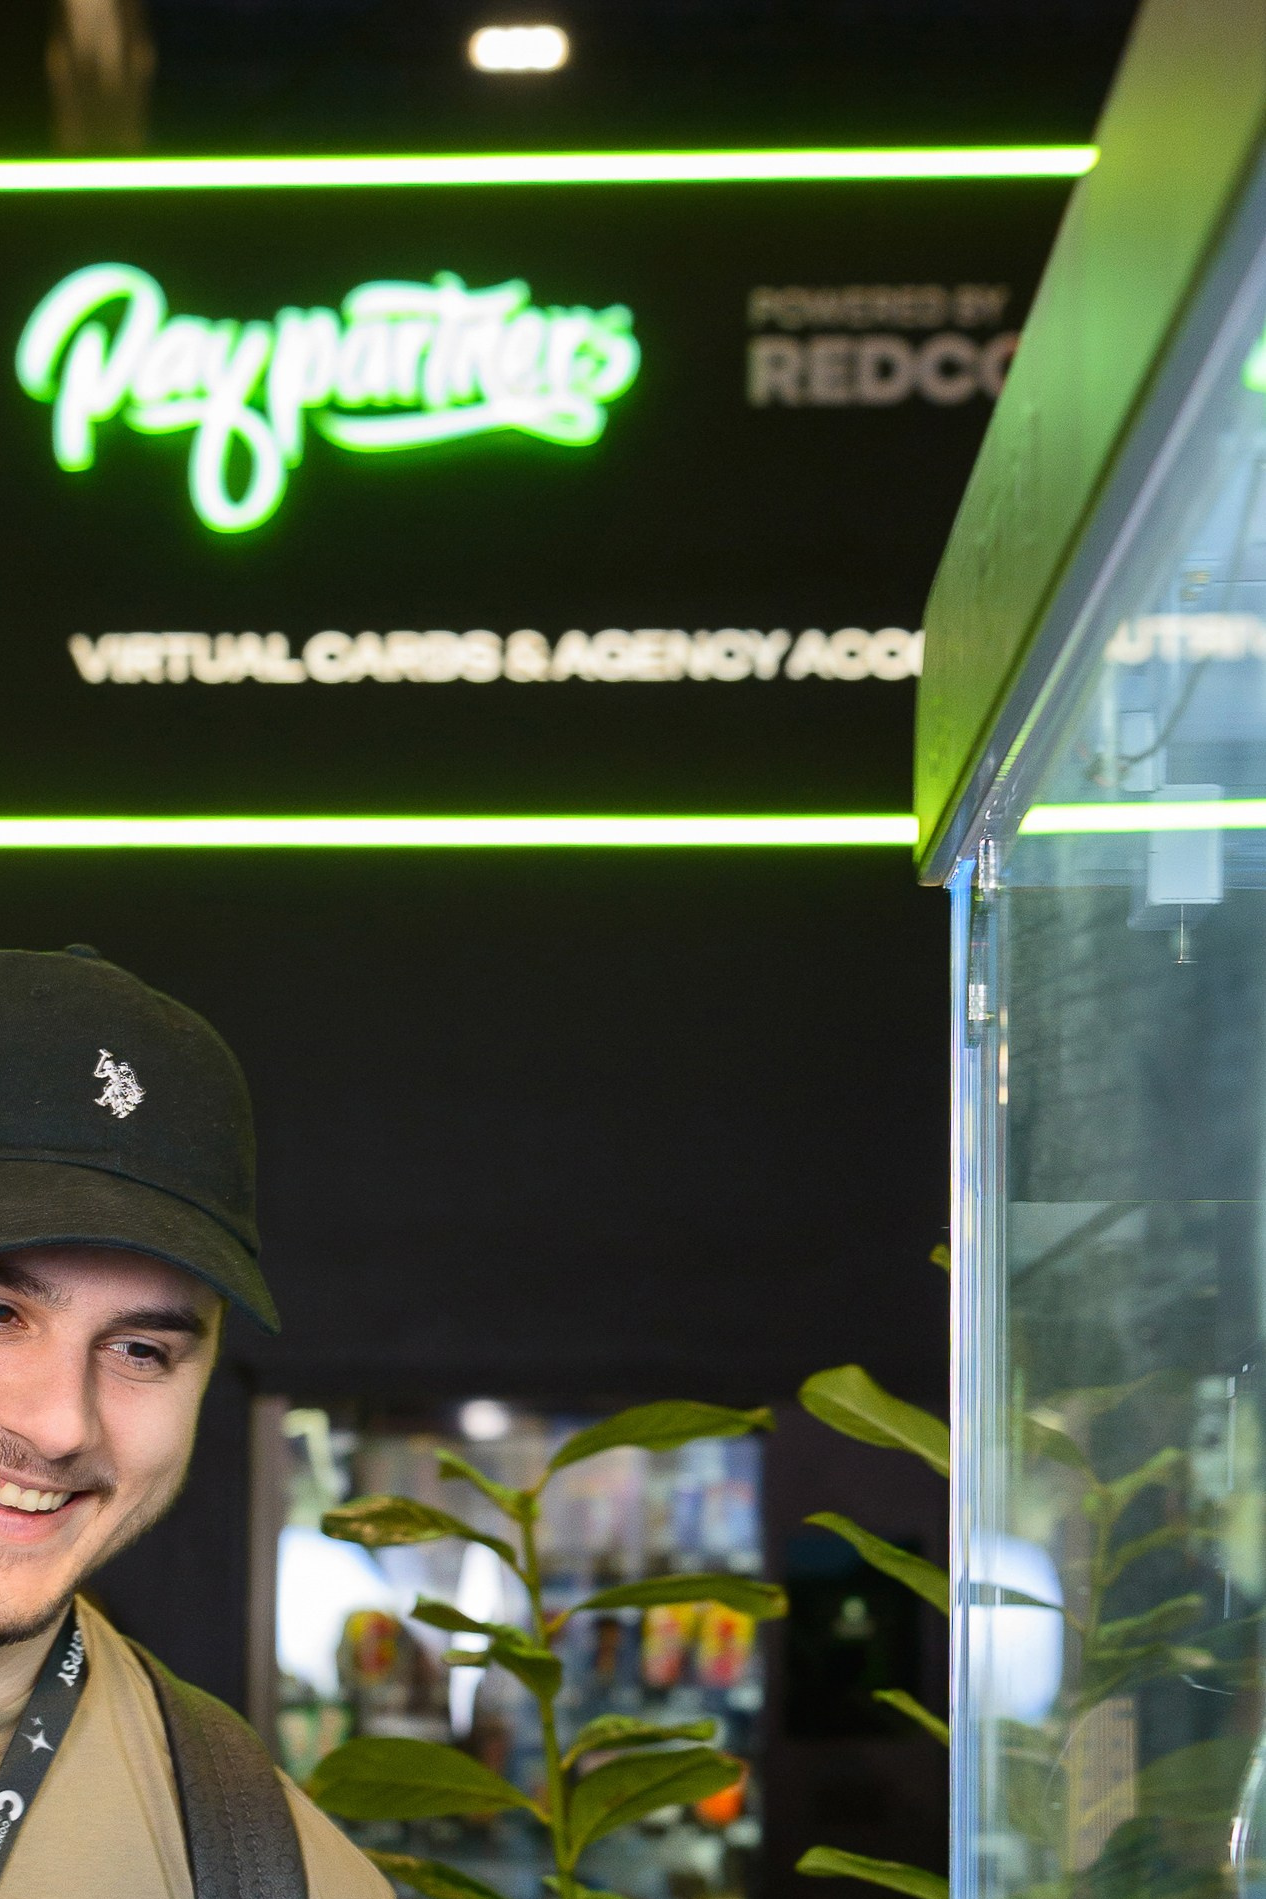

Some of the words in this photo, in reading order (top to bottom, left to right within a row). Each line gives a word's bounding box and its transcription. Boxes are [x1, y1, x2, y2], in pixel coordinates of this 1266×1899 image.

[747, 285, 948, 329] POWERED
[952, 283, 1009, 327] BY
[67, 632, 306, 683] VIRTUAL
[302, 630, 503, 683] CARDS
[504, 629, 549, 682] &
[548, 628, 790, 682] AGENCY
[785, 628, 925, 681] ACC
